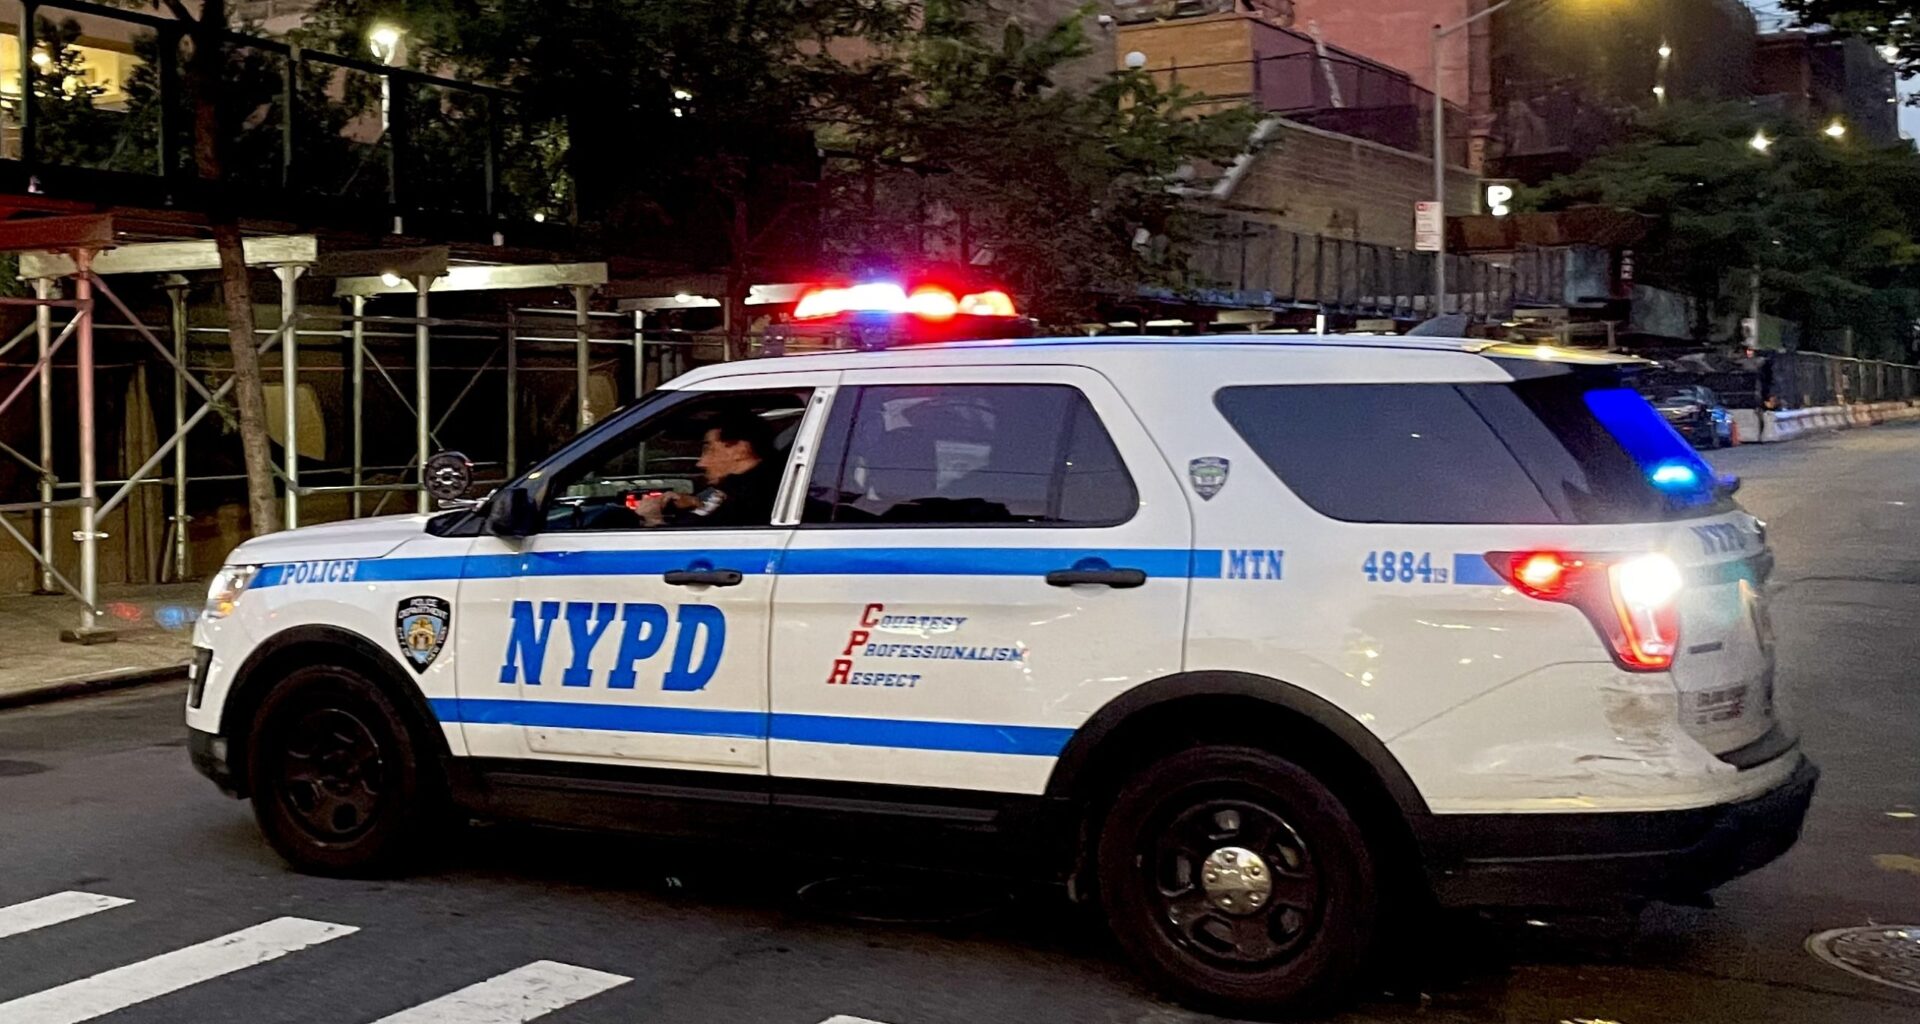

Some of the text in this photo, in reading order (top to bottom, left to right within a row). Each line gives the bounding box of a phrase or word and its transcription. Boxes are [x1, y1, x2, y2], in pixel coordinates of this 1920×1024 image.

[281, 560, 355, 585] POLICE
[1228, 549, 1284, 580] MTN
[1361, 551, 1431, 583] 4884
[398, 606, 449, 619] DEPARTMENT
[410, 598, 438, 607] POLICE
[499, 600, 727, 691] NYPD
[843, 630, 1028, 661] PROFESSIONALISM
[827, 659, 921, 687] RESPECT
